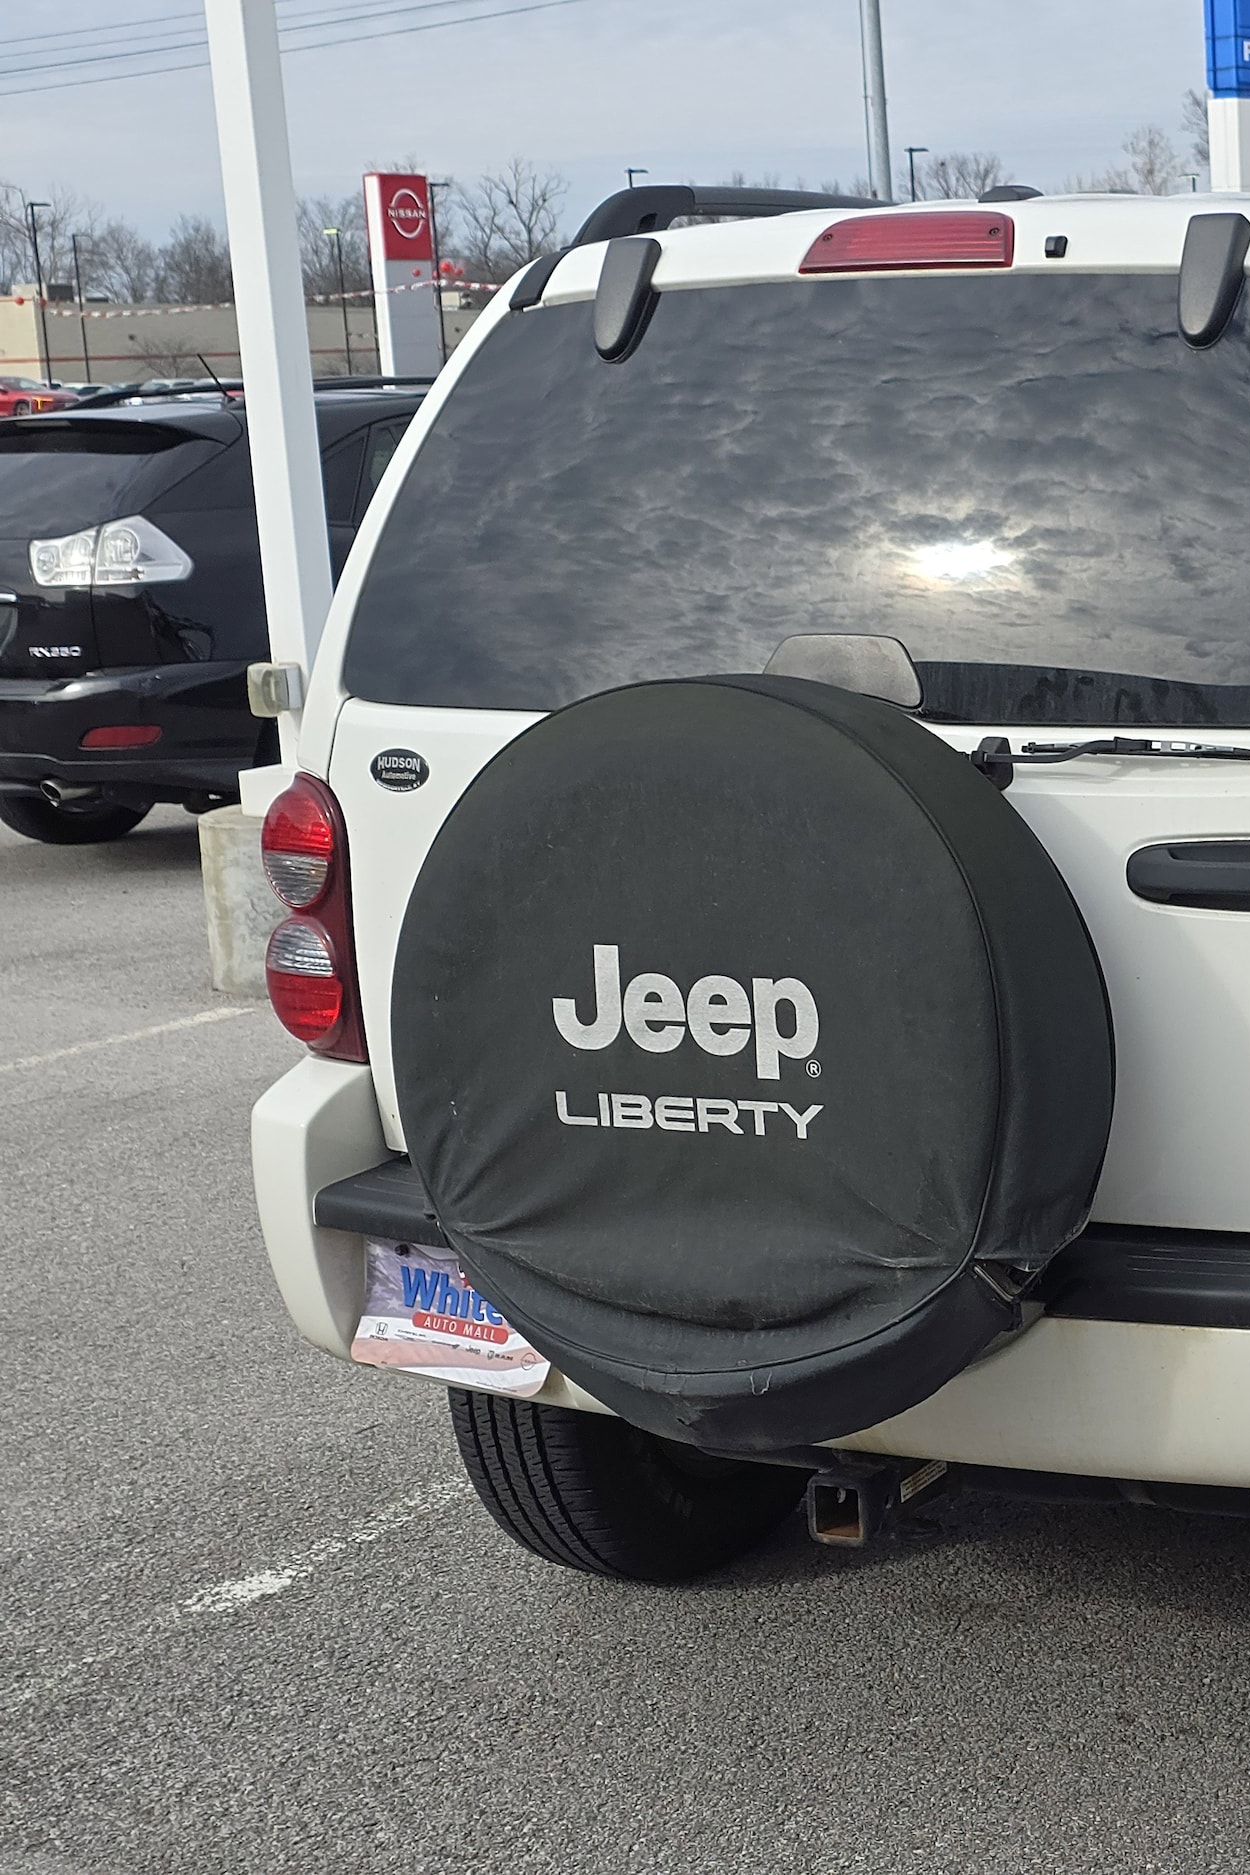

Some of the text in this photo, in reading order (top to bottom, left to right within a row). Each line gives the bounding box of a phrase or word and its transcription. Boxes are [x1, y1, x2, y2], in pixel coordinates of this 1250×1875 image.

[387, 208, 426, 218] NISSAN
[377, 756, 420, 772] HUDSON
[381, 770, 417, 780] Automotive
[552, 944, 819, 1080] Jeep
[555, 1091, 824, 1139] LIBERTY
[424, 1316, 457, 1333] AUTO
[463, 1323, 495, 1341] MALL
